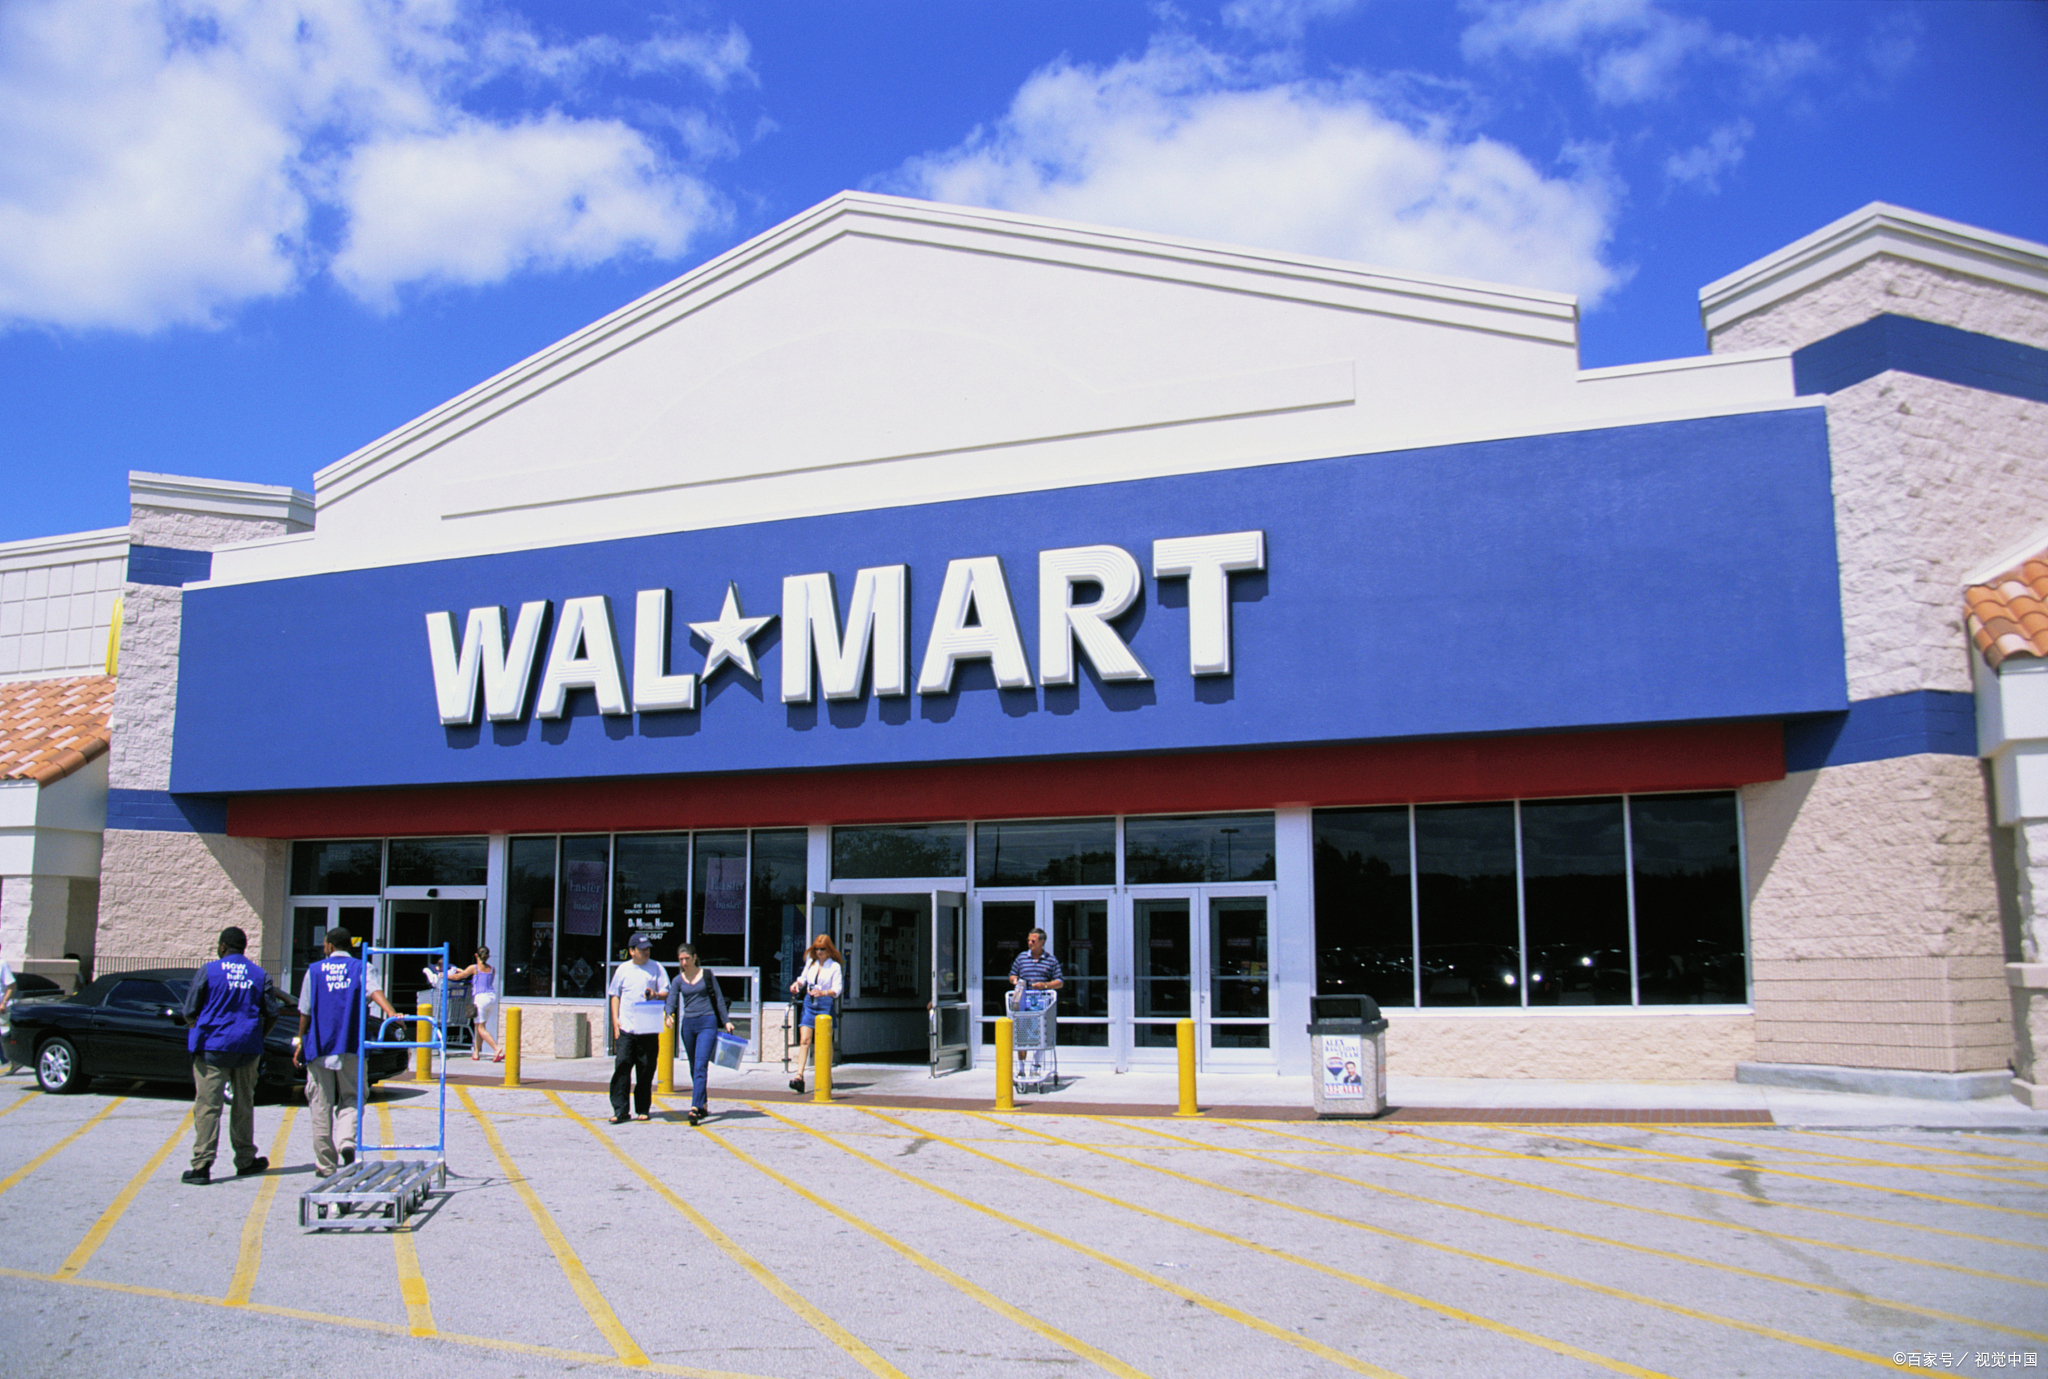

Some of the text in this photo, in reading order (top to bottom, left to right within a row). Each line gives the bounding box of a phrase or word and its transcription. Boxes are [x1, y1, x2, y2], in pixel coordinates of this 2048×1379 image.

[781, 529, 1265, 705] MART
[221, 961, 247, 971] How
[321, 962, 347, 972] How
[226, 972, 245, 980] help
[326, 974, 344, 982] help
[228, 979, 253, 990] you?
[327, 978, 351, 992] you?
